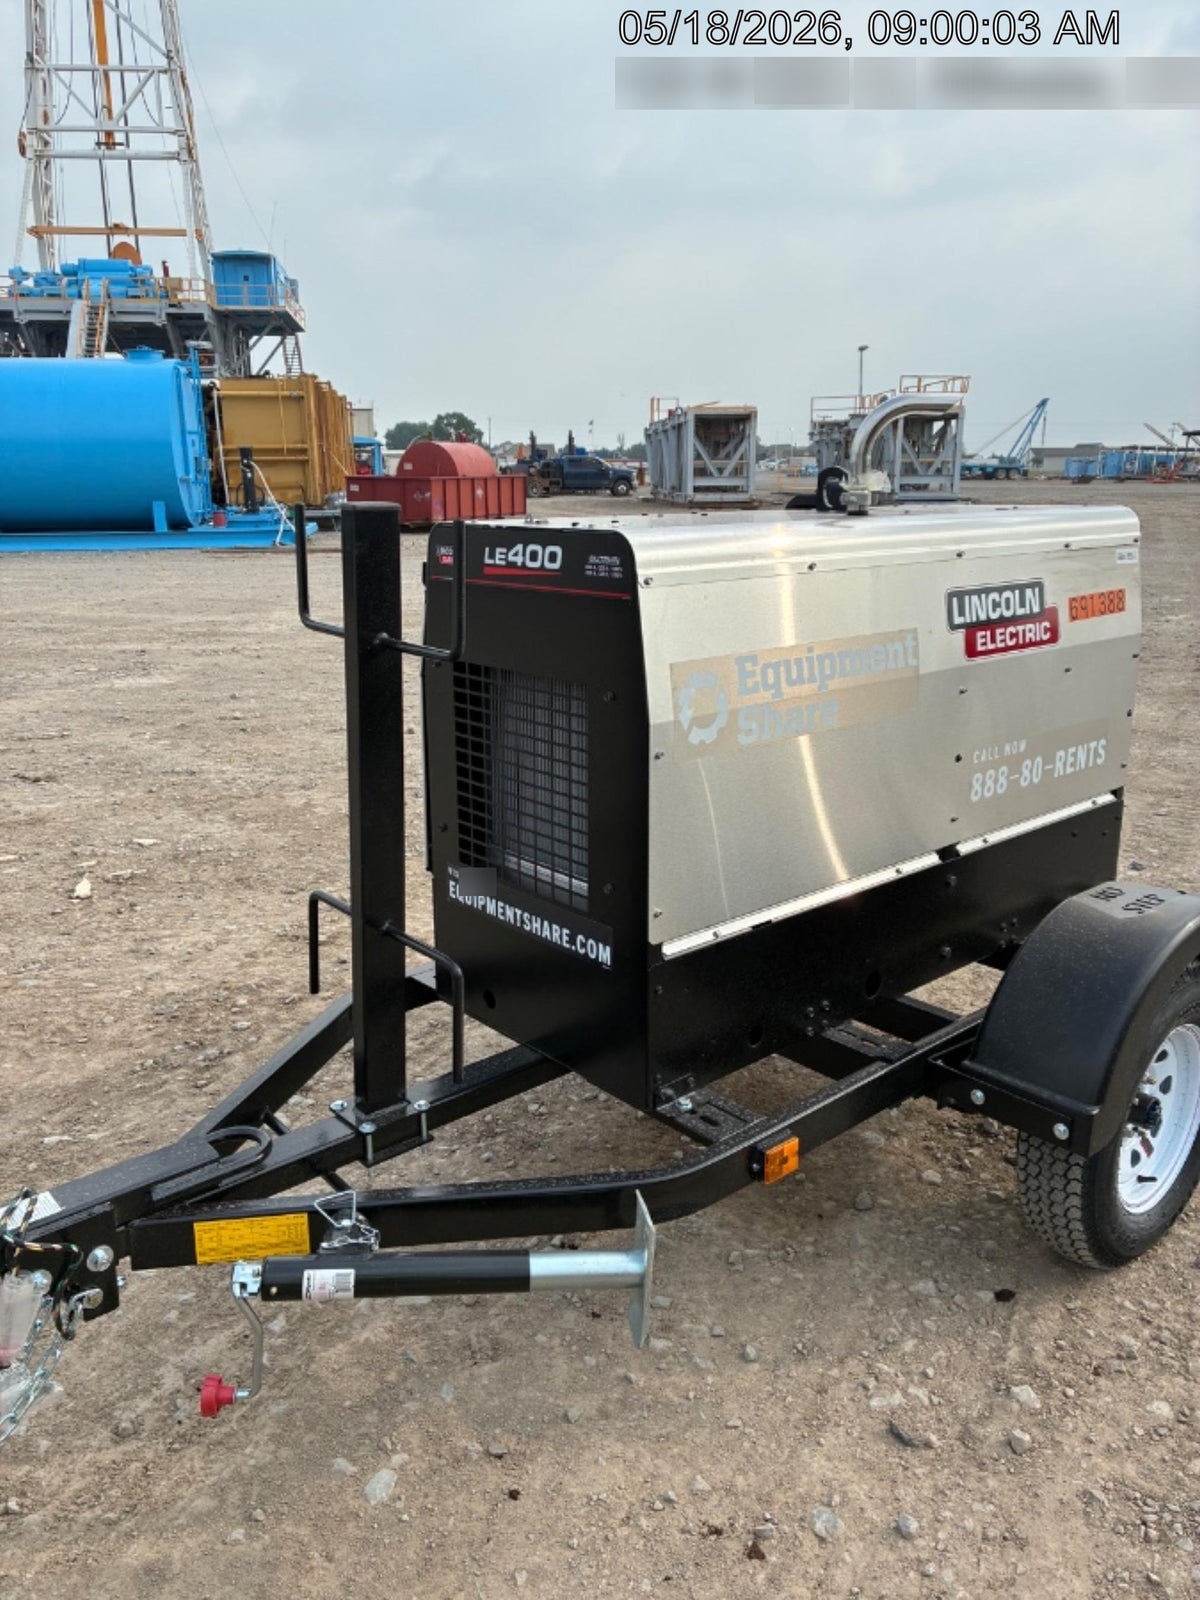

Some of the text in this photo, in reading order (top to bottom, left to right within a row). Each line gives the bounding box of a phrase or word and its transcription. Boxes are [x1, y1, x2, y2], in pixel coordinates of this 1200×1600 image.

[484, 543, 562, 570] LE400
[952, 587, 1040, 625] LINCOLN
[1070, 589, 1126, 620] 691388
[975, 621, 1051, 651] ELECTRIC
[734, 634, 919, 700] Equipment
[736, 698, 839, 745] Share
[973, 739, 1027, 764] CALL NOW
[970, 738, 1107, 802] 888-80-RENTS
